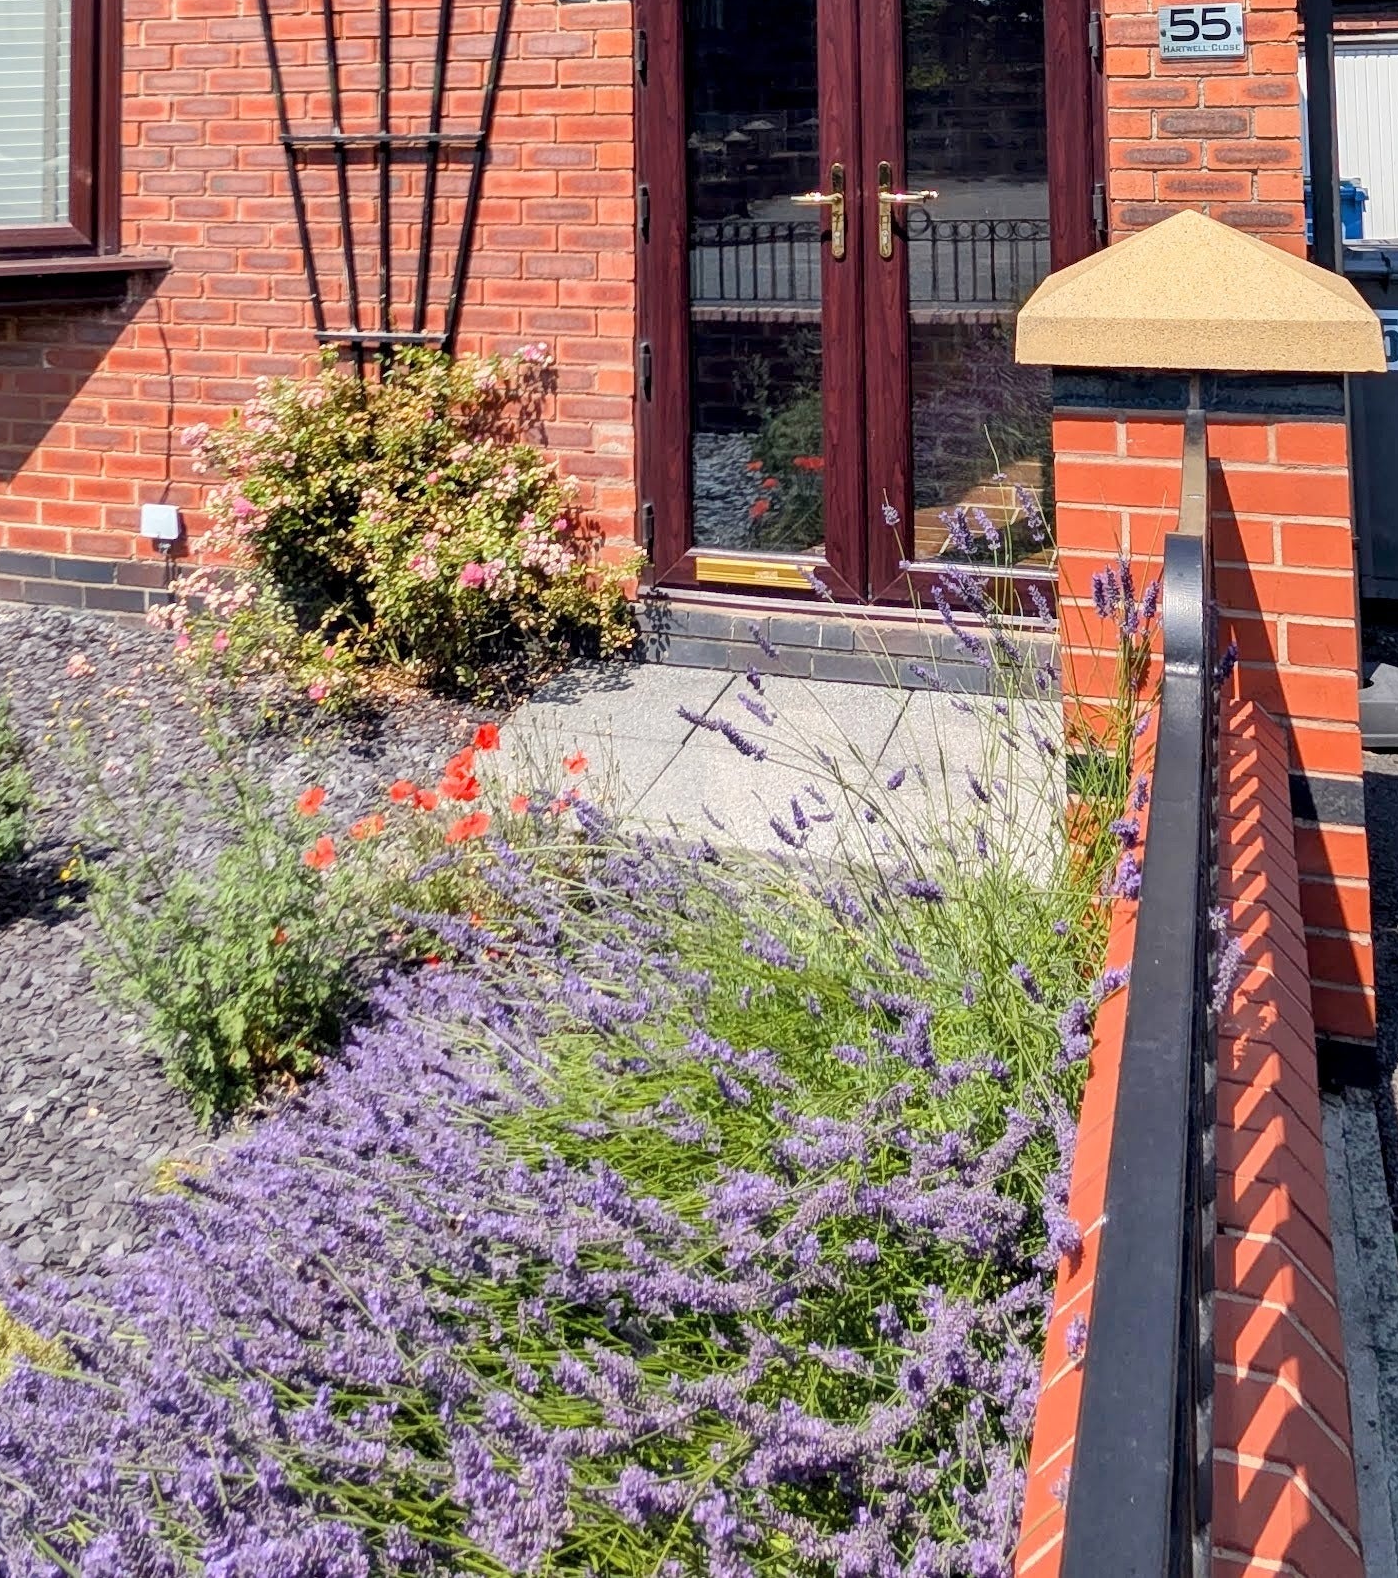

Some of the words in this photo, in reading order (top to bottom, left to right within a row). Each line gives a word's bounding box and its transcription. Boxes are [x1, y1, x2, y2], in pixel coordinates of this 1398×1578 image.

[1170, 7, 1232, 42] 55
[1163, 44, 1207, 54] HARTWELL
[1211, 43, 1241, 52] CLOSE
